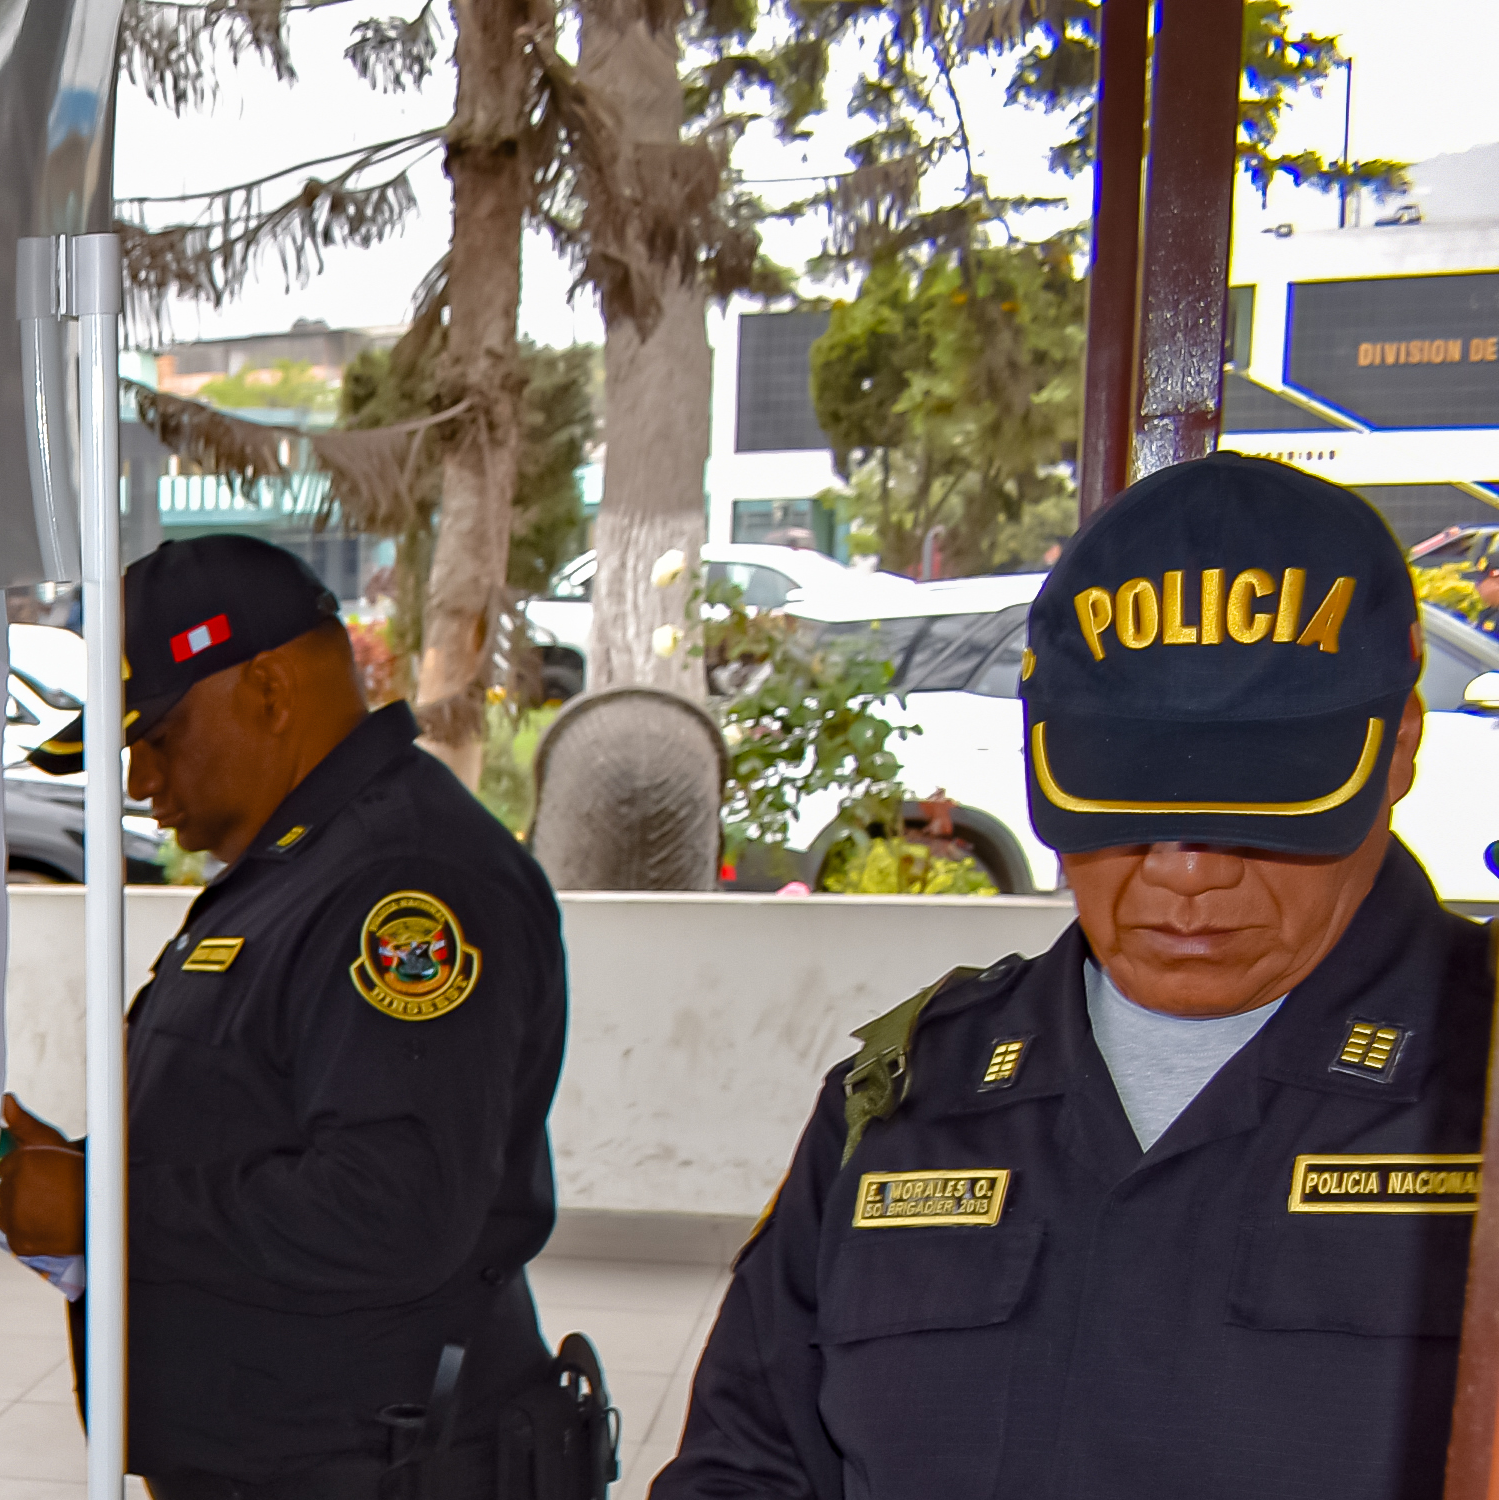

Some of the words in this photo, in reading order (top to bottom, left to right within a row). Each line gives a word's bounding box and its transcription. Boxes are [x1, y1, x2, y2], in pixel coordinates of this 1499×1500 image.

[1357, 338, 1463, 367] DIVISION
[1468, 336, 1498, 363] DE
[1074, 567, 1356, 662] POLICIA
[889, 1179, 967, 1200] MORALES
[1304, 1171, 1380, 1195] POLICIA
[959, 1200, 990, 1213] 2013
